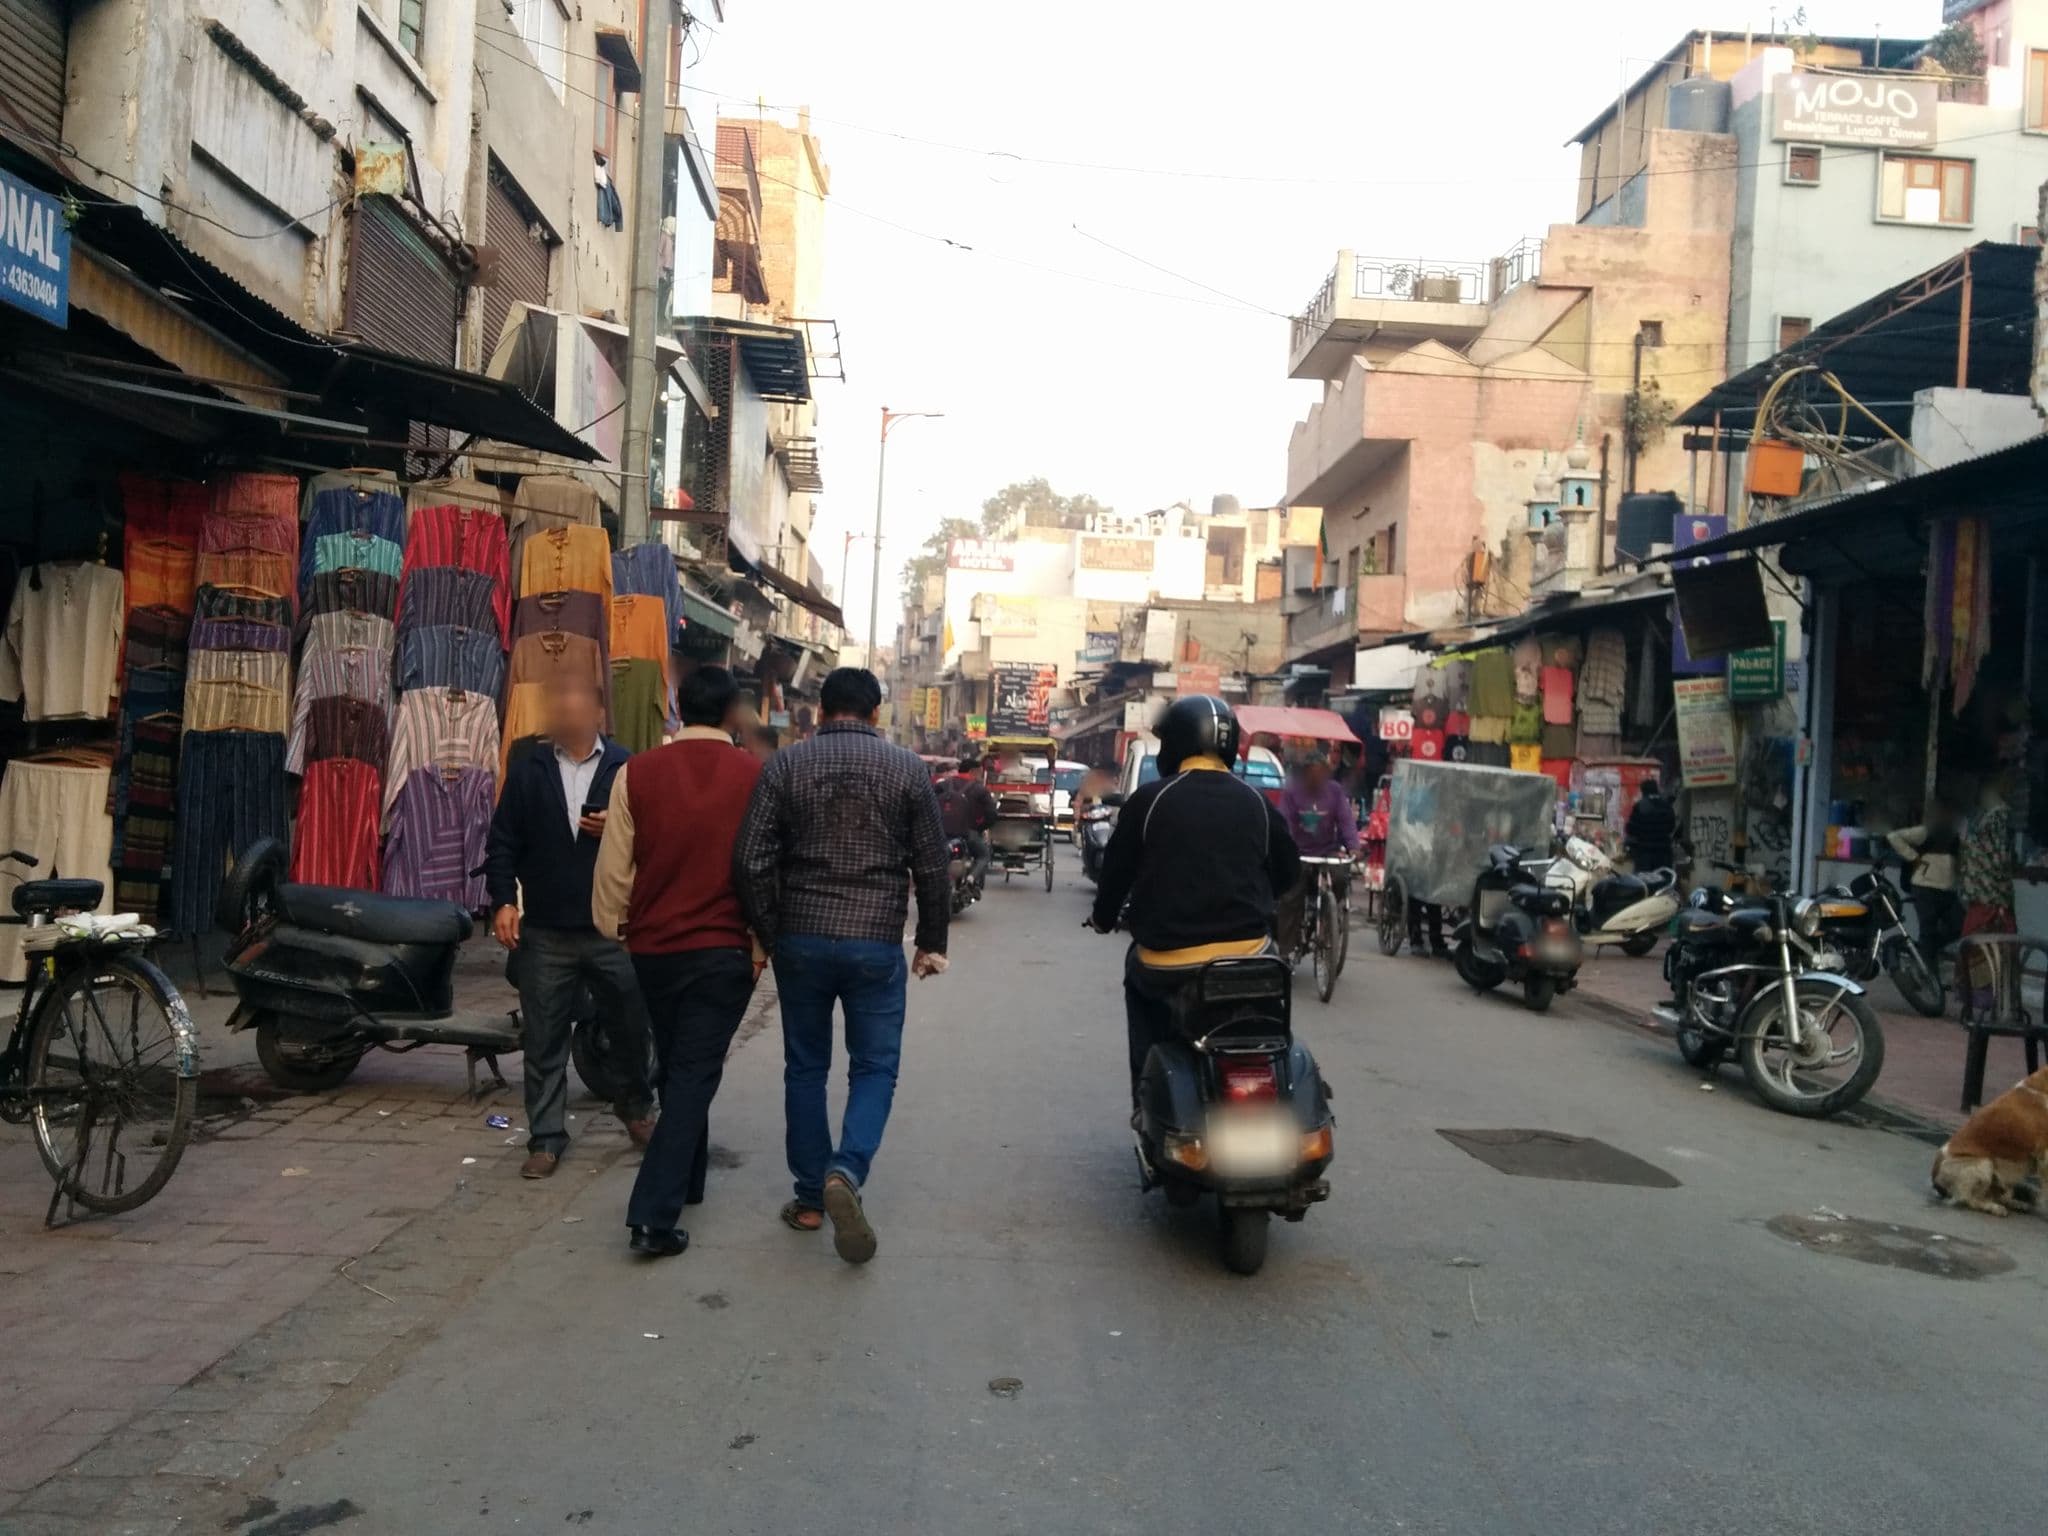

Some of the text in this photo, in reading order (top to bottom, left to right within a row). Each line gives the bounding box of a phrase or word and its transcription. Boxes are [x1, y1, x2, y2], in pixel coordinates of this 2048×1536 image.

[1794, 79, 1919, 119] MOJO
[1814, 111, 1864, 124] TERRACE
[1783, 119, 1840, 134] Breakfast
[1846, 125, 1882, 137] Lunch
[1889, 127, 1929, 140] Dinner
[8, 263, 58, 309] 43630404
[959, 558, 1006, 570] HOTEL
[1732, 658, 1772, 669] PALACE
